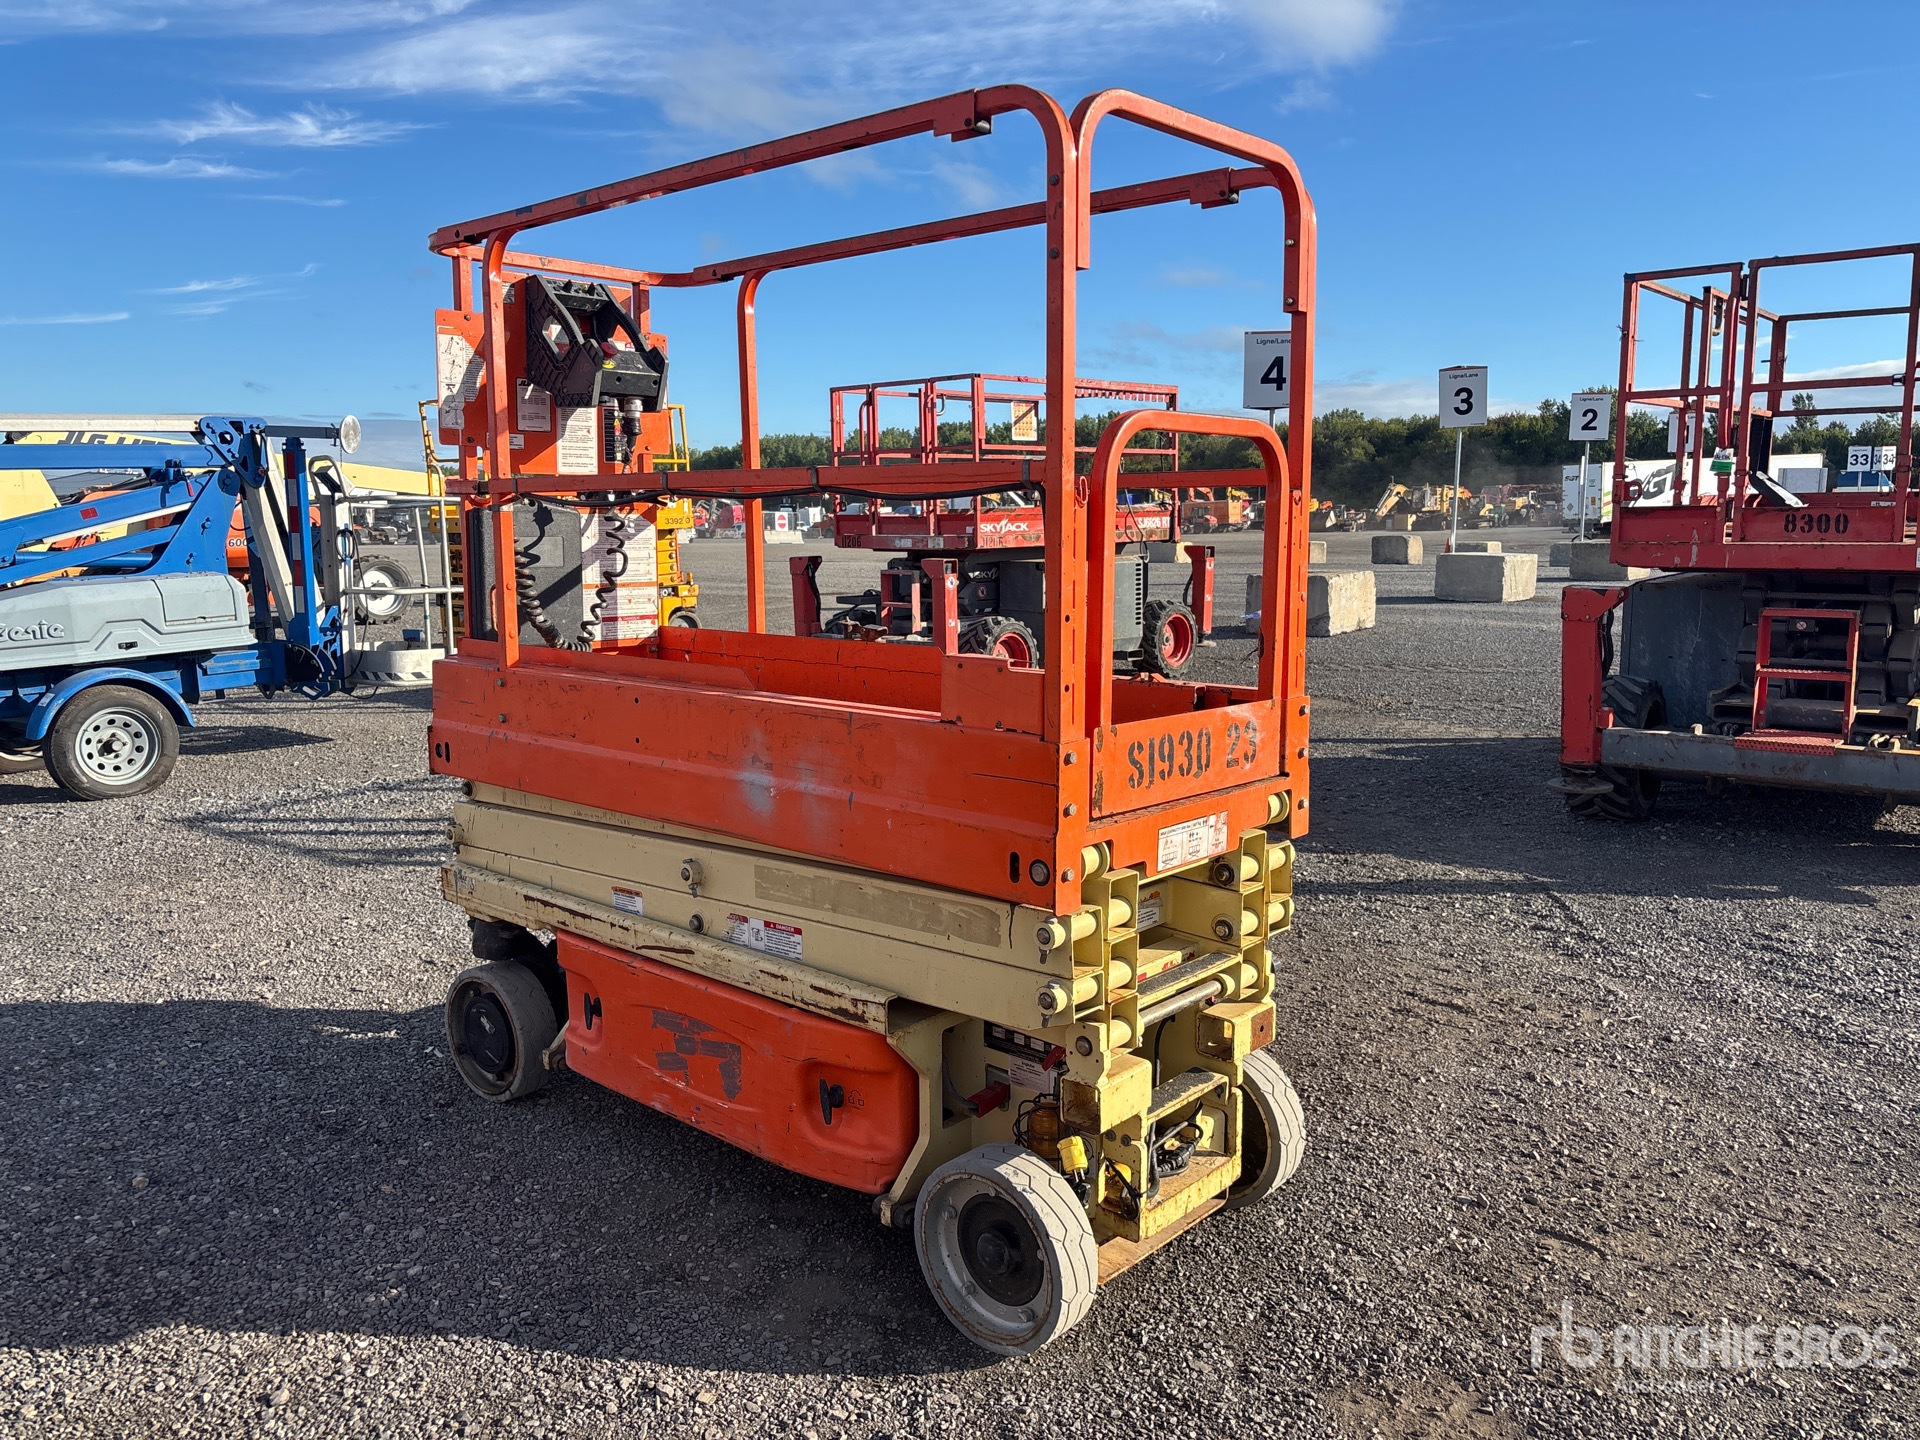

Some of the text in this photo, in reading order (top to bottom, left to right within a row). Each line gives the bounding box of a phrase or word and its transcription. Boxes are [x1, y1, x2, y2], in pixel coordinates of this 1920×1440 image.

[1260, 356, 1287, 391] 4
[1453, 387, 1473, 415] 3
[1581, 408, 1598, 431] 2
[1850, 454, 1869, 465] 33
[980, 519, 1029, 534] SKYJACK
[1784, 513, 1849, 534] 8300
[1226, 720, 1257, 768] 23
[775, 923, 795, 933] DANGER
